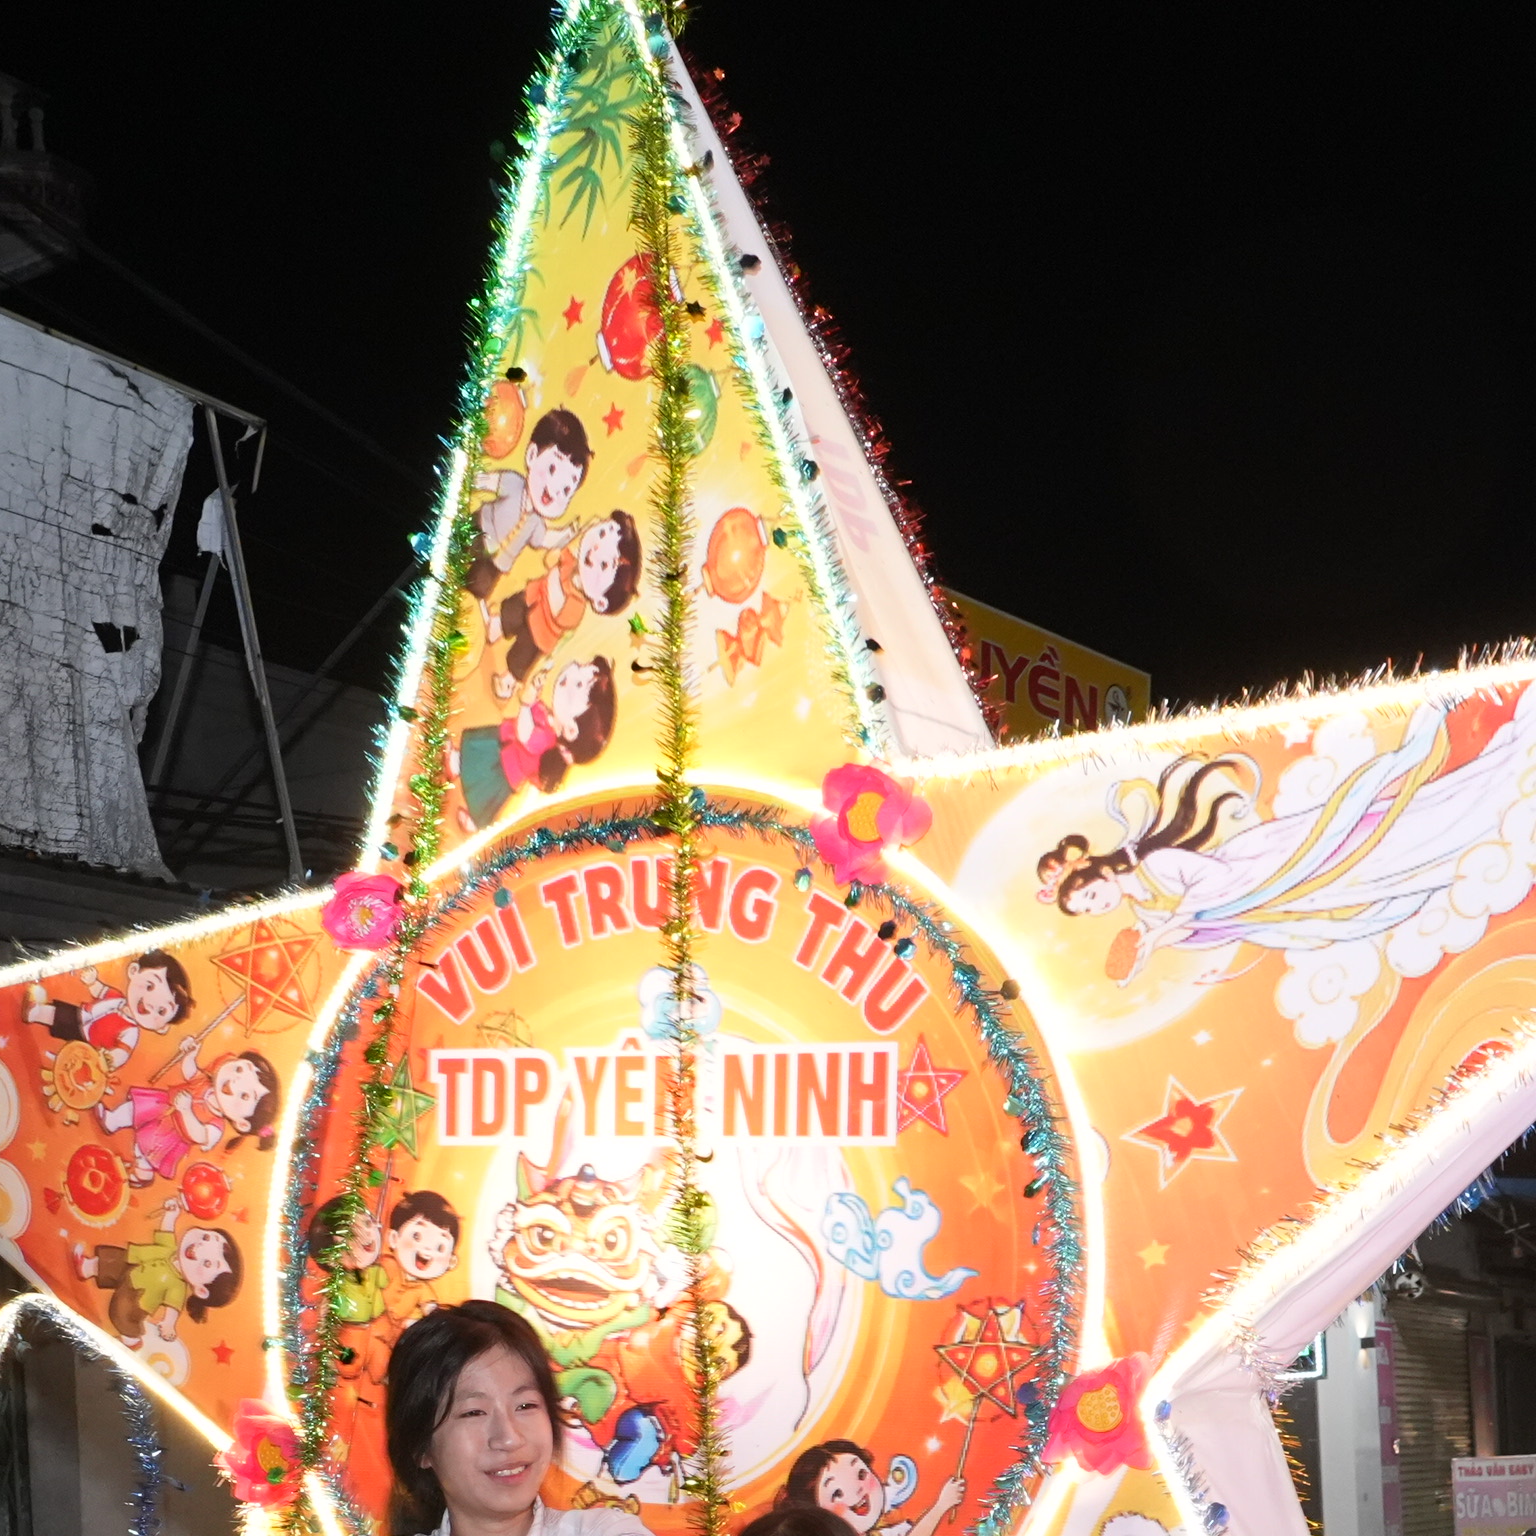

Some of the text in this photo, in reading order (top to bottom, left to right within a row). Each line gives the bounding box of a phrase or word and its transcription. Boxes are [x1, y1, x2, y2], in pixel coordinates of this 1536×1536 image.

[417, 858, 930, 1035] VUI TRUNG THU
[438, 1037, 889, 1136] TDP YÊN NINH
